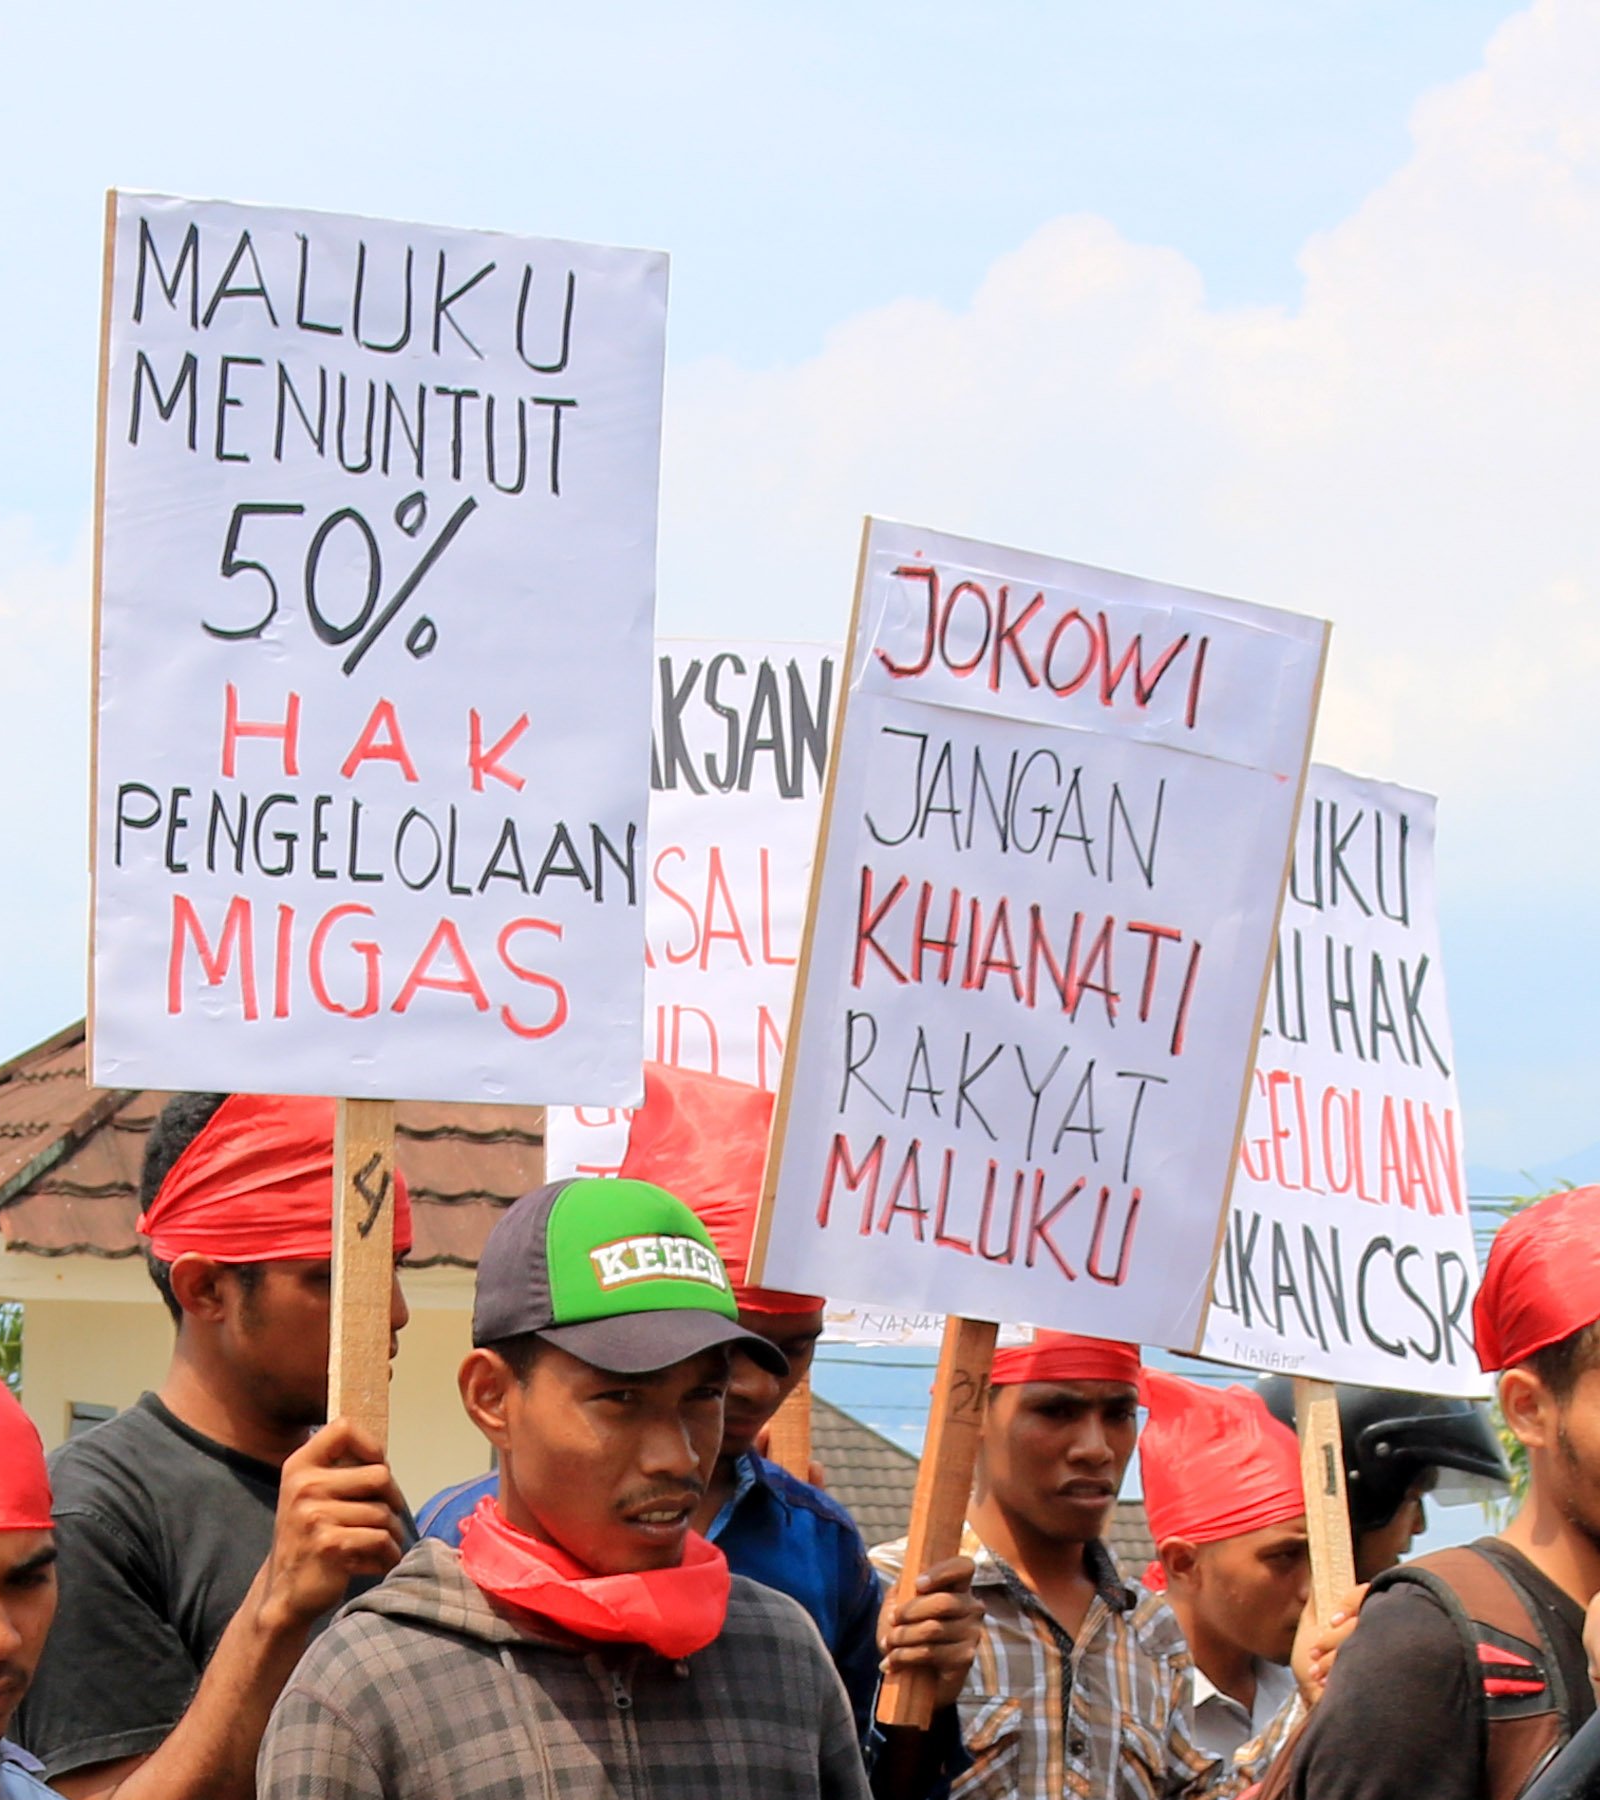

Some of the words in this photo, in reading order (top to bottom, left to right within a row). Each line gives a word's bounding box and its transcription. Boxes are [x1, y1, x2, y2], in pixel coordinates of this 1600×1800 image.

[132, 216, 575, 374] MALUKU
[128, 350, 578, 497] MENUNTUT
[200, 490, 478, 675] 50%
[874, 560, 1210, 729] JOKOWI
[220, 679, 531, 792] HAK
[864, 727, 1165, 888] JANGAN
[114, 781, 636, 905] PENGELOLAAN
[166, 893, 568, 1040] MIGAS
[851, 865, 1201, 1056] KHIANATI
[1325, 936, 1450, 1081] HAK
[838, 1009, 1169, 1184] RAKYAT
[816, 1133, 1141, 1287] MALUKU
[1357, 1235, 1475, 1367] CSR
